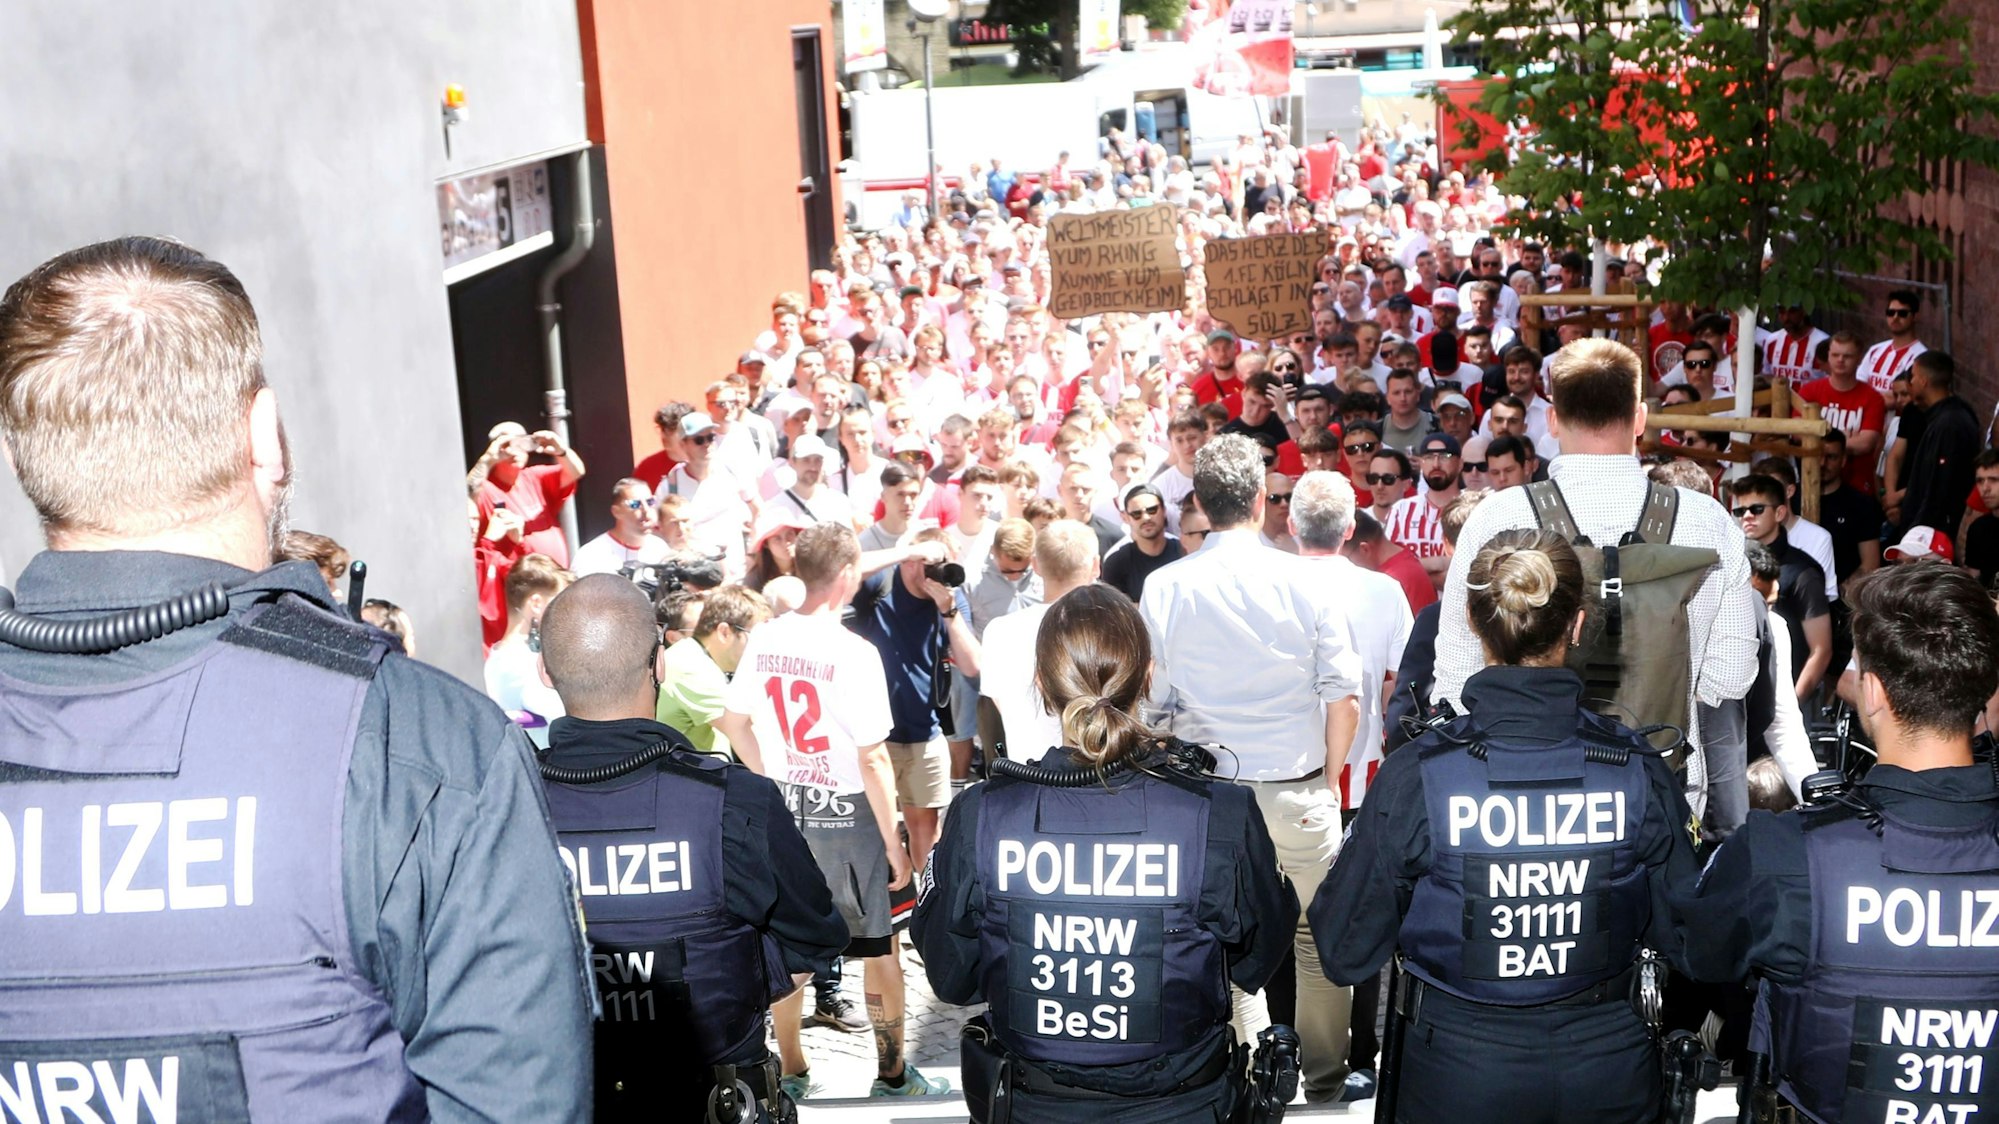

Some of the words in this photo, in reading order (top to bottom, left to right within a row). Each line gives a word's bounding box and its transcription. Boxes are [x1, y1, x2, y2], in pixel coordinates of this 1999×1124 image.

[1051, 206, 1175, 242] WELTMEISTER
[1097, 240, 1157, 266] RHING
[1208, 242, 1238, 263] DAS
[1241, 236, 1288, 260] HERZ
[1292, 233, 1326, 256] DES
[1058, 269, 1118, 292] KUMME
[1263, 260, 1309, 282] KÖLN
[1208, 284, 1283, 310] SCHLÄGT
[1290, 283, 1309, 301] IN
[1247, 308, 1308, 336] SÜLZ!
[1406, 542, 1447, 558] REW
[764, 676, 830, 755] 12
[806, 787, 856, 816] 96
[1449, 791, 1626, 848] POLIZEI
[0, 796, 257, 916] LIZEI
[998, 840, 1179, 897] POLIZEI
[1489, 859, 1590, 898] NRW
[1034, 913, 1137, 956] NRW
[1490, 901, 1582, 938] 31111
[1847, 886, 1999, 947] POLIZ
[1030, 954, 1135, 998] 3113
[1498, 941, 1576, 978] BAT
[1036, 999, 1128, 1040] BeSi
[1881, 1006, 1999, 1048] NRW
[1894, 1052, 1984, 1094] 3111
[1884, 1099, 1979, 1124] BAT
